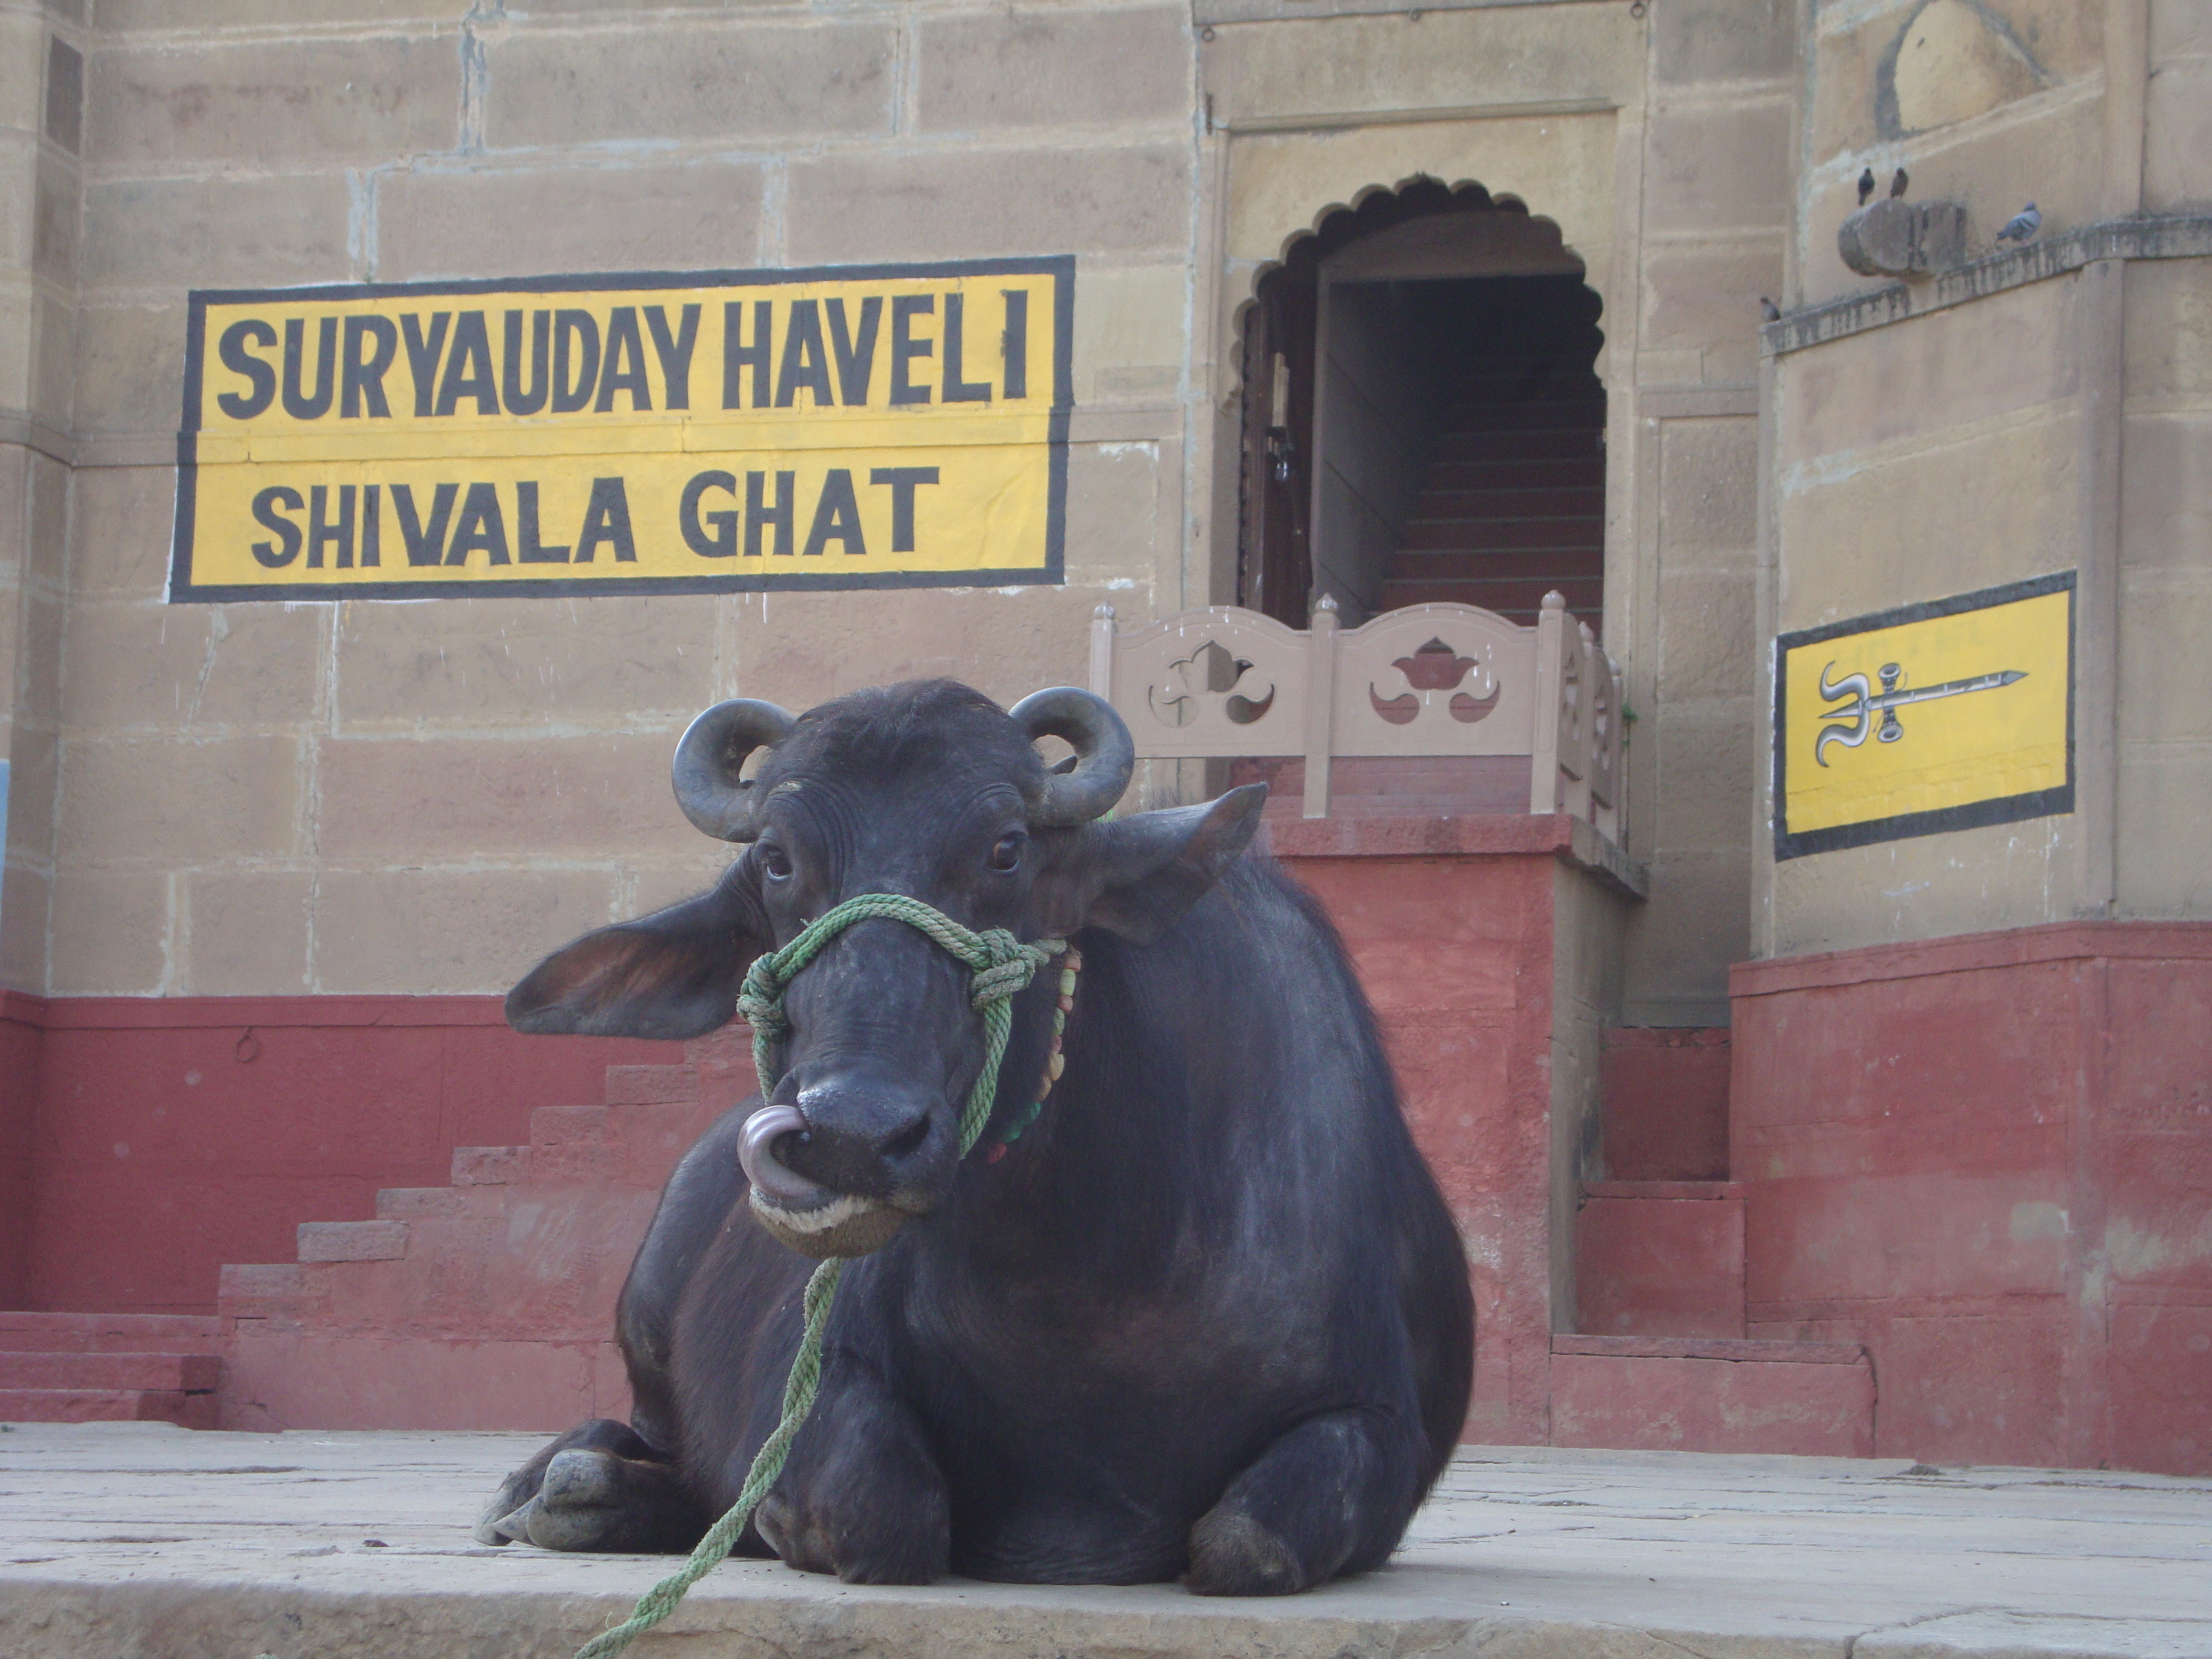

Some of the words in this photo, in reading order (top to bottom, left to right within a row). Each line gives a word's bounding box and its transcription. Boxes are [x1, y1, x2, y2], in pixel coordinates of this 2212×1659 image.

[218, 305, 701, 419] SURYAUDAY
[723, 291, 1027, 409] HAVELI
[252, 478, 637, 568] SHIVALA
[680, 468, 939, 557] GHAT
